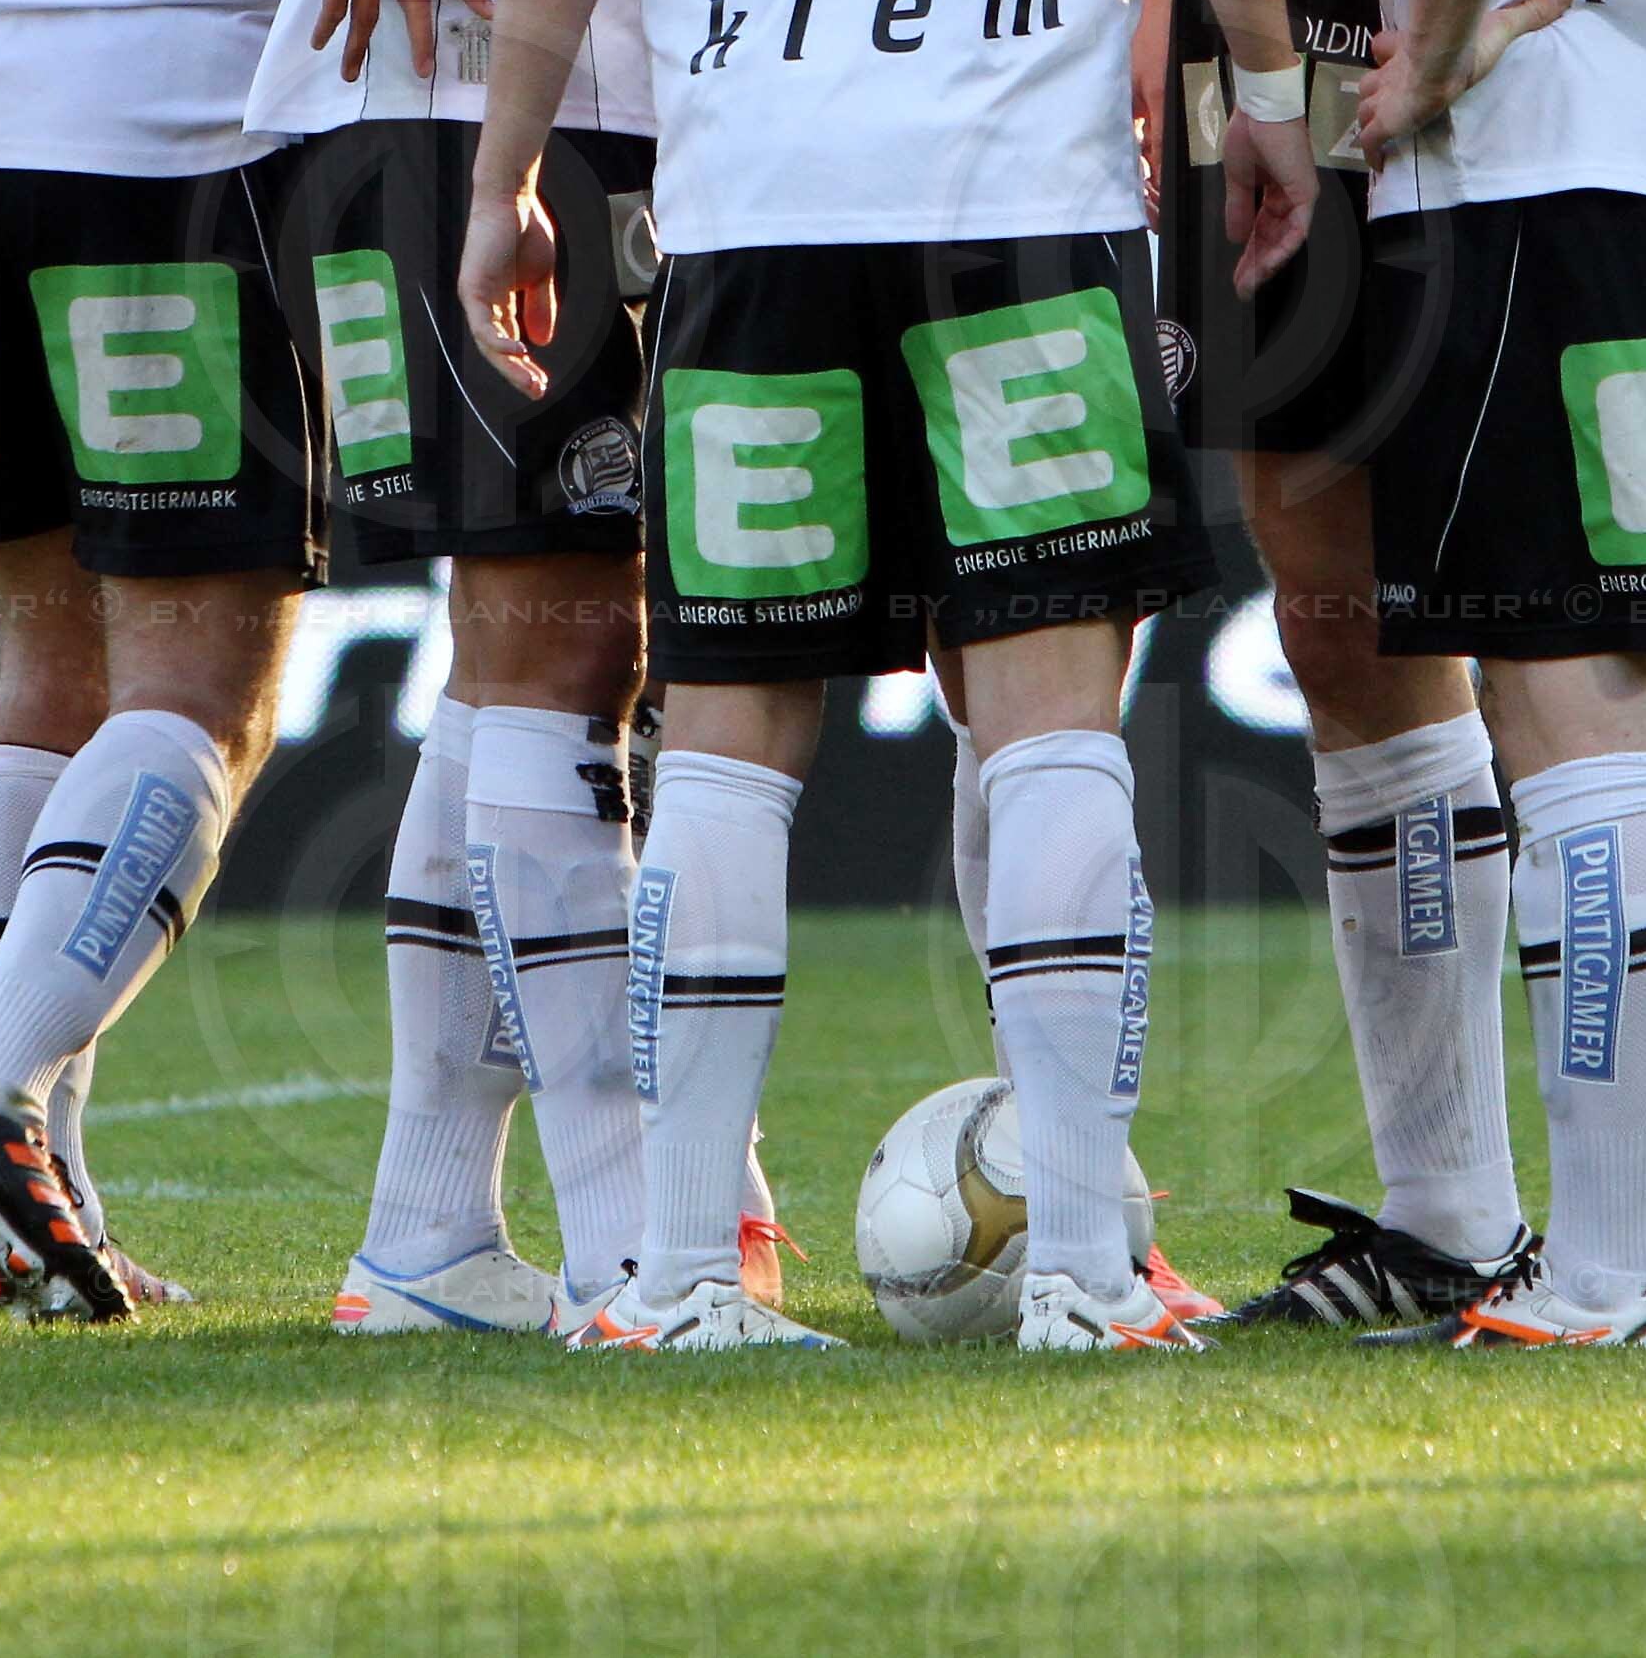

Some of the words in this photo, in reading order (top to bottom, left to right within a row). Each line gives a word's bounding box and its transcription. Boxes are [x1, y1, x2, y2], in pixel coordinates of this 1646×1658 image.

[69, 293, 203, 454] E
[944, 328, 1115, 510] E
[691, 402, 835, 570] E
[955, 544, 1027, 577] ENERGIE
[1036, 517, 1153, 559] STEIERMARK
[678, 604, 748, 626] ENERGIE
[1569, 838, 1612, 1070] PUNTIGAMER
